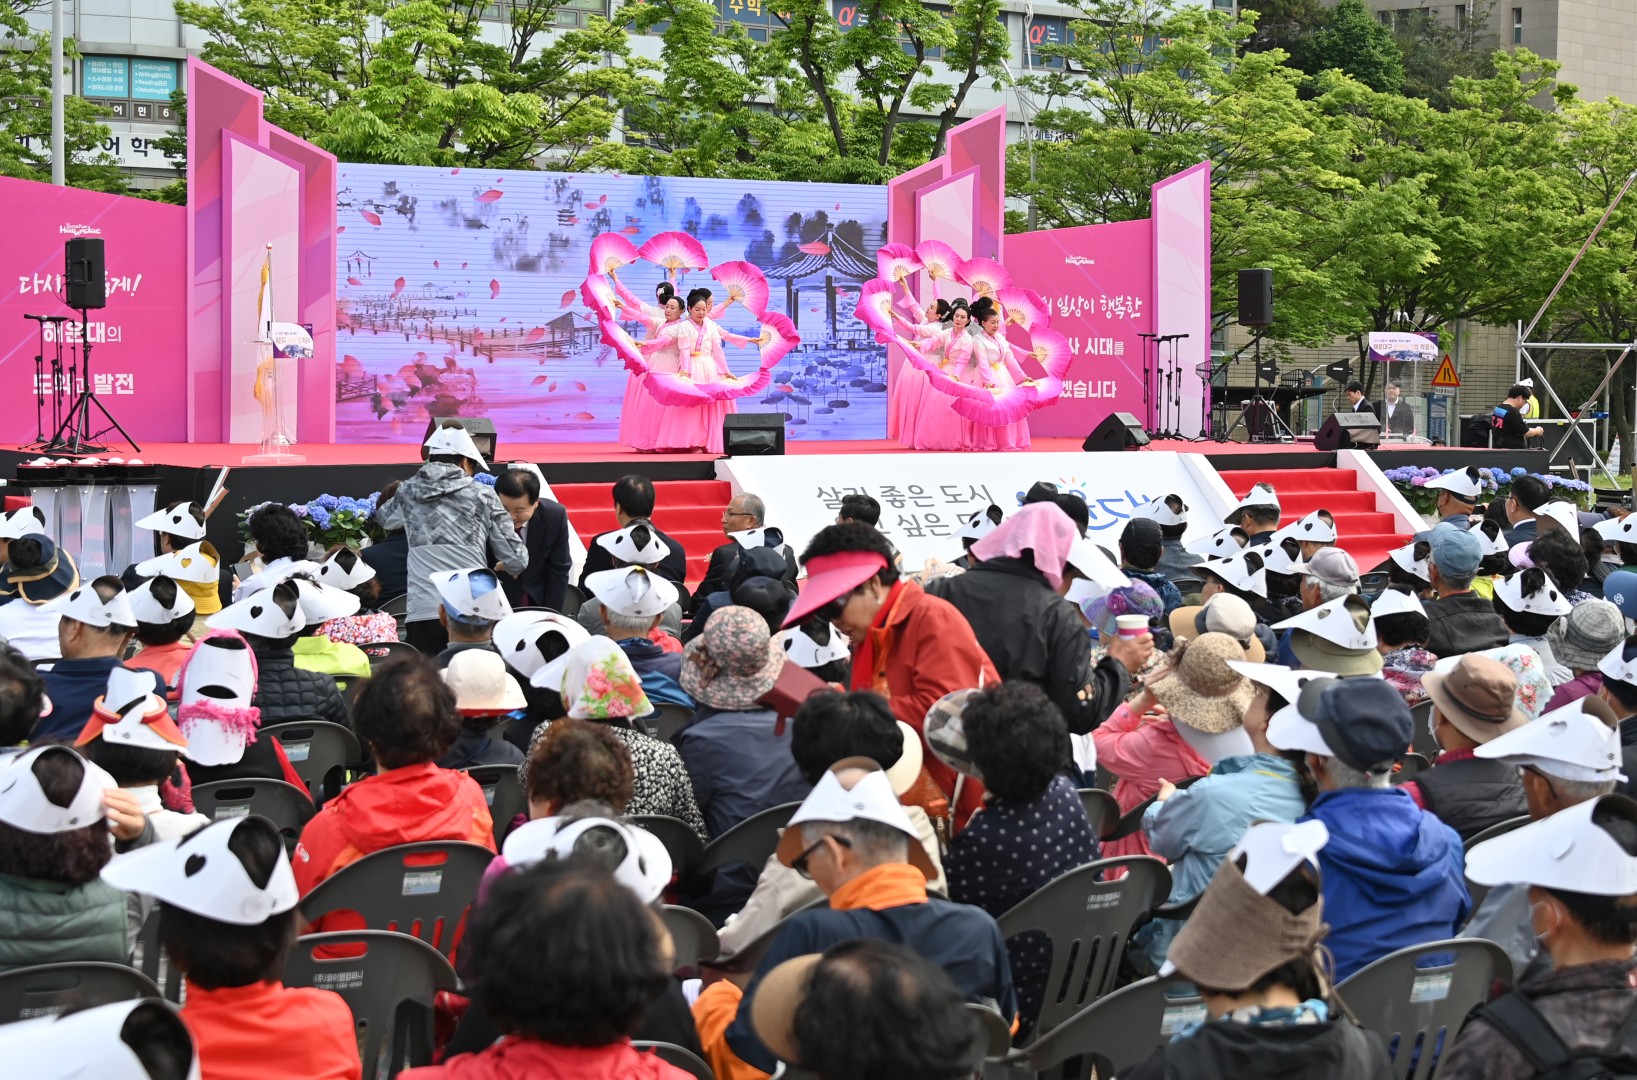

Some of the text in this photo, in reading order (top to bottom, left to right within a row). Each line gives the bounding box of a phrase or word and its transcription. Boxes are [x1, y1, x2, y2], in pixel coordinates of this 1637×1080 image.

[19, 273, 62, 295] 다시
[1057, 294, 1095, 317] 일상이
[1100, 294, 1142, 319] 행복한
[43, 322, 122, 343] 해운대의
[1084, 337, 1124, 355] 시대를
[94, 374, 134, 395] 발전
[880, 484, 935, 509] 좋은
[939, 484, 996, 504] 도시
[897, 512, 951, 537] 싶은
